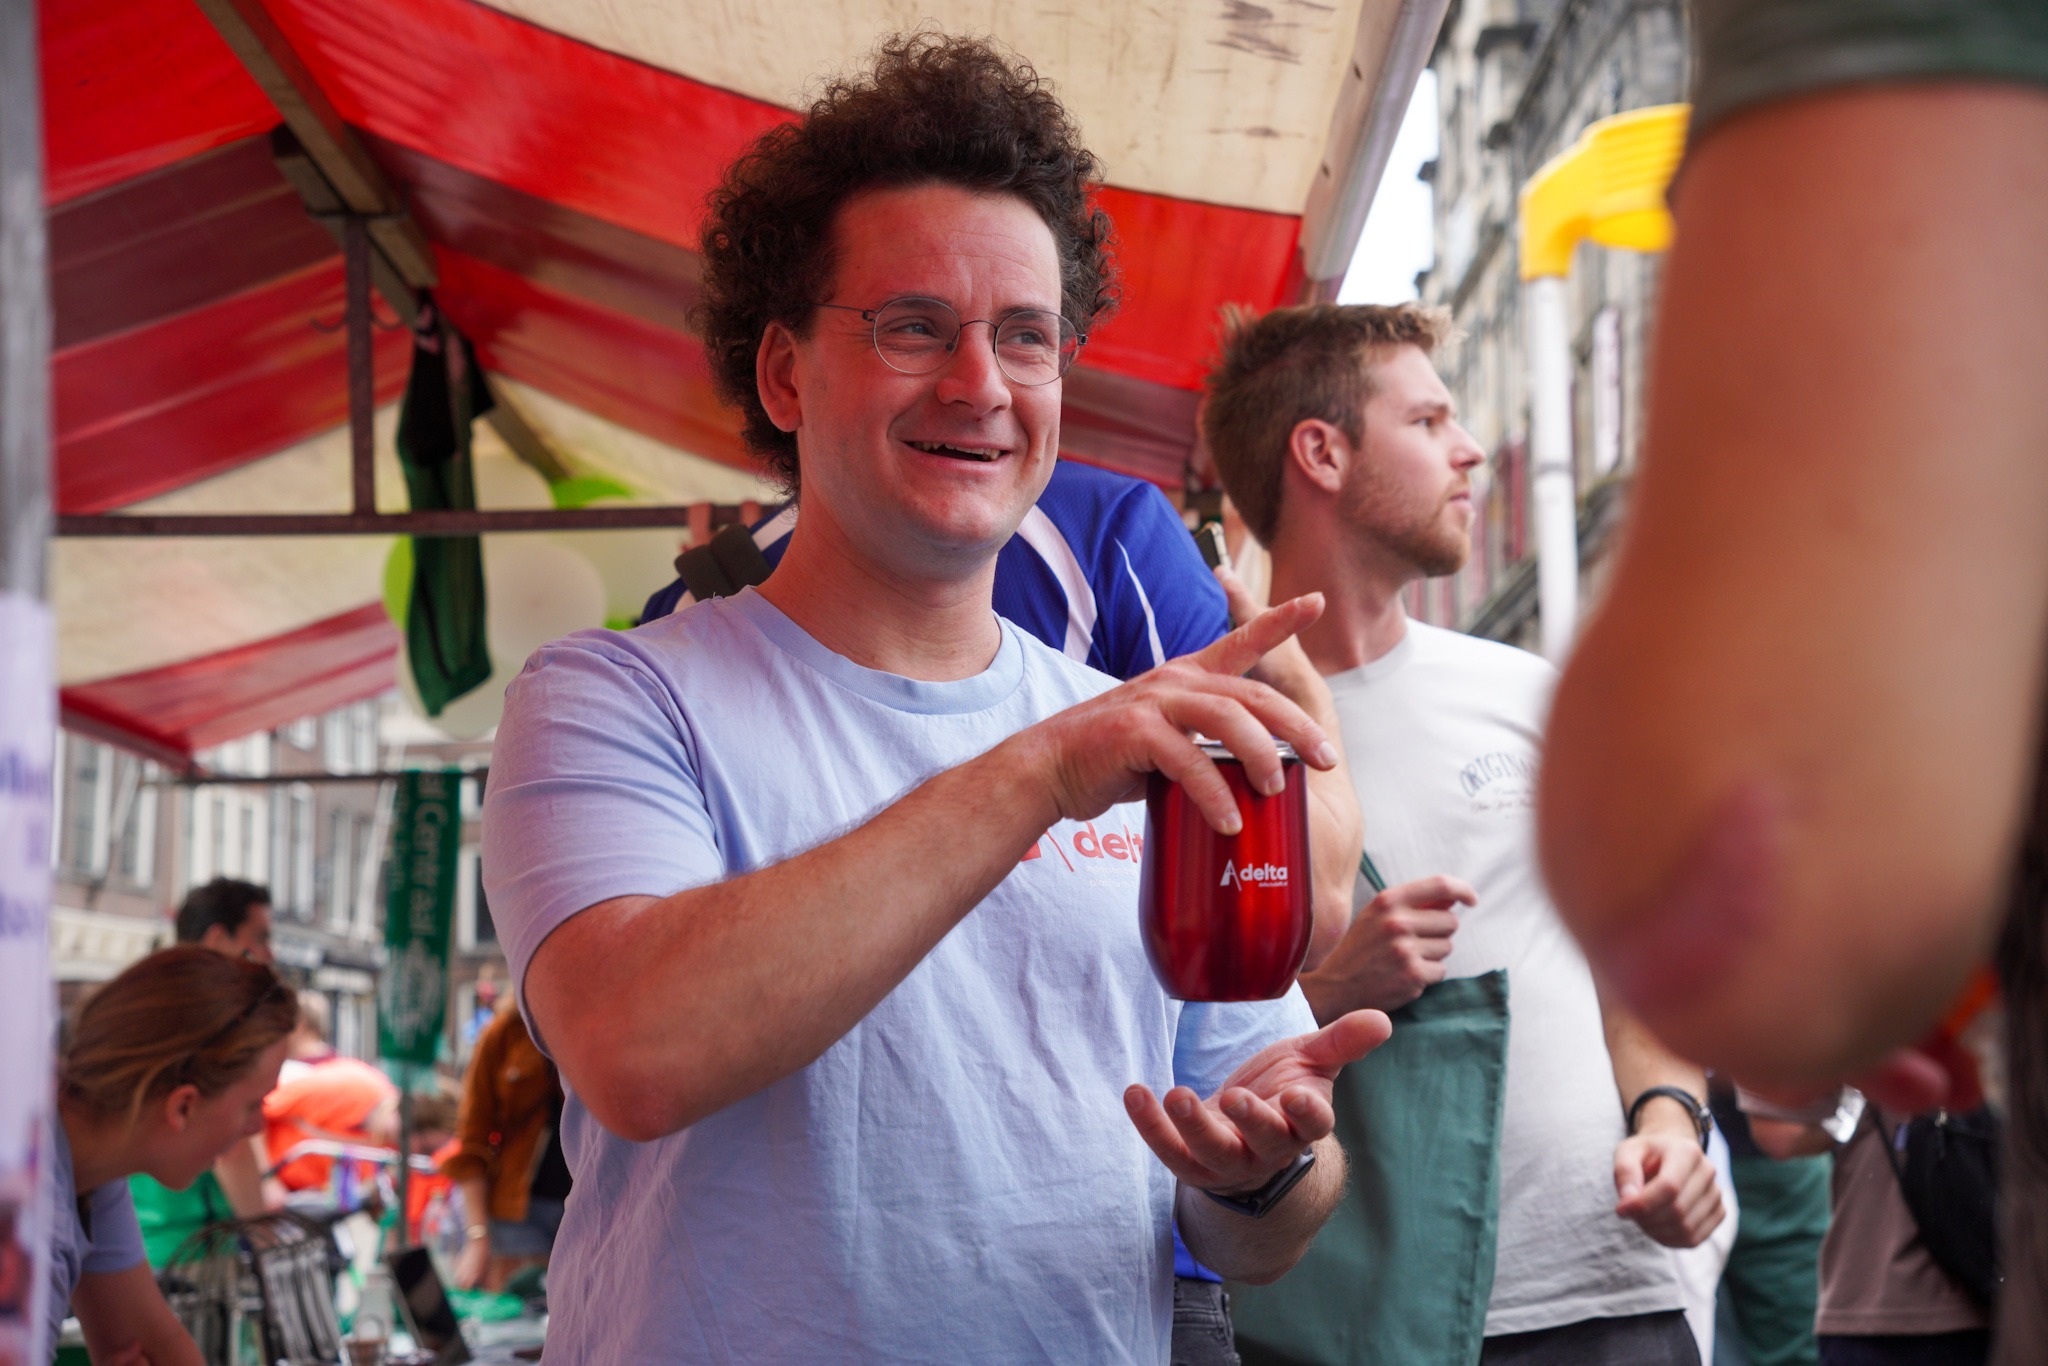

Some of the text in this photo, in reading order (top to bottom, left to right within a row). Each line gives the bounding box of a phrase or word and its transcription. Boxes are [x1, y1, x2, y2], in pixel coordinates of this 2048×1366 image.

[1459, 751, 1538, 798] ORIGIN
[1073, 821, 1144, 863] delt
[1240, 862, 1288, 881] delta
